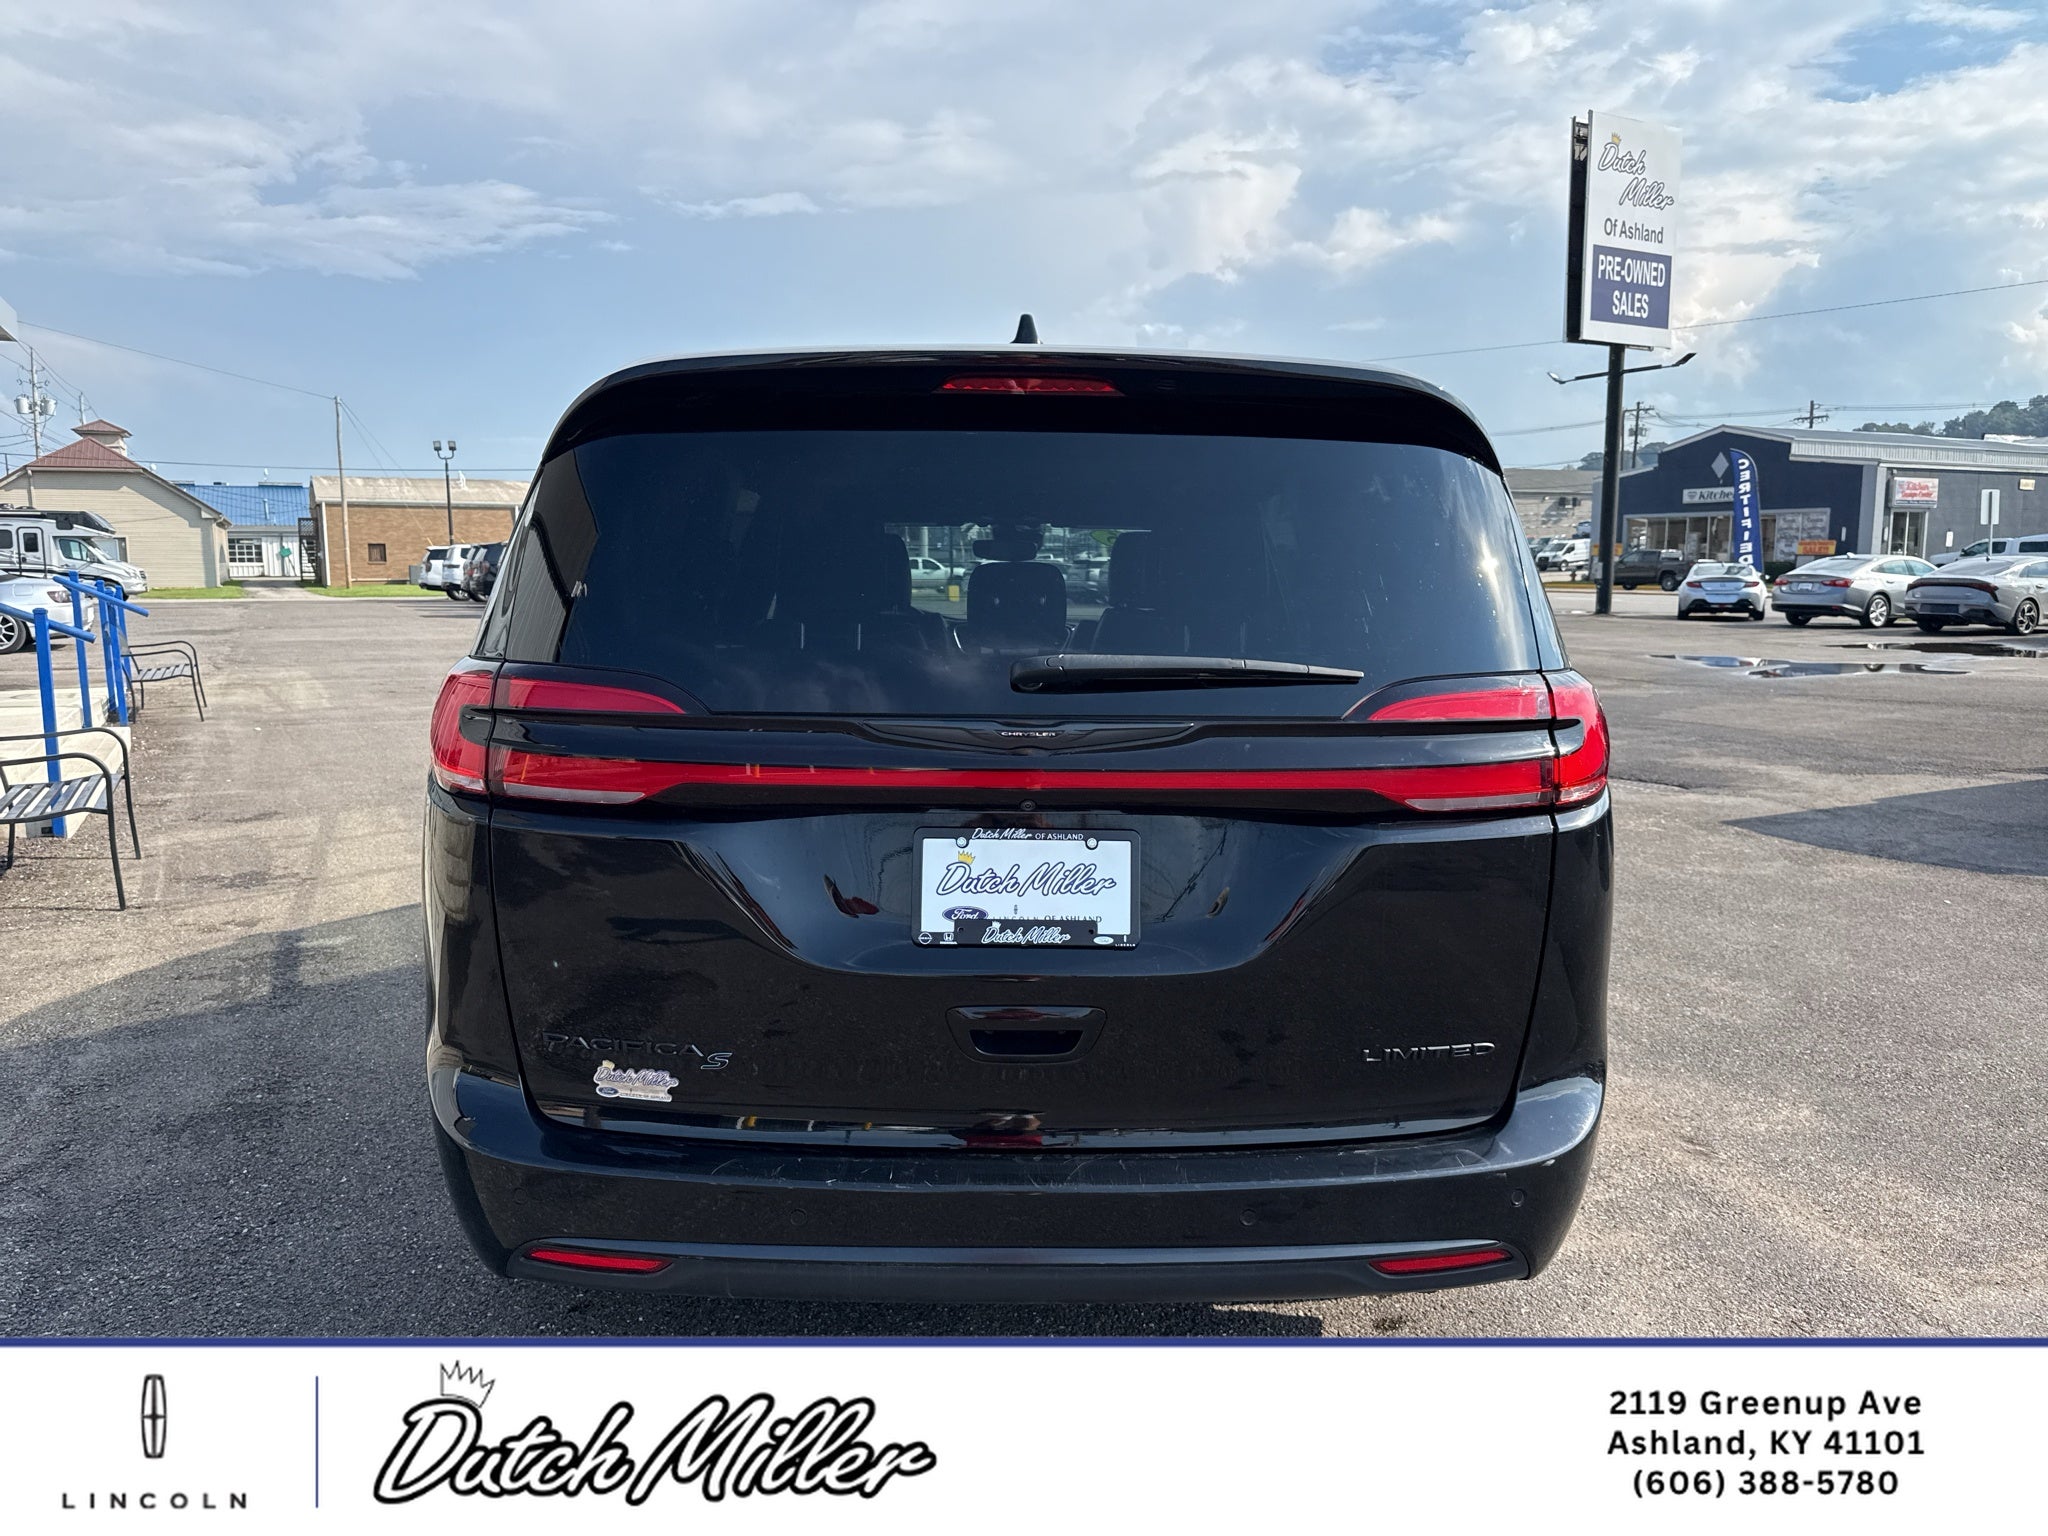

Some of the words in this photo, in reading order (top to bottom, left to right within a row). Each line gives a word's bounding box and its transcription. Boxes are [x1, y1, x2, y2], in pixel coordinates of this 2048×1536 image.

[1598, 142, 1646, 175] Dutch
[1619, 177, 1674, 210] Miller
[1604, 217, 1618, 237] Of
[1619, 219, 1664, 244] Ashland
[1598, 254, 1666, 288] PRE-OWNED
[1612, 290, 1649, 319] SALES
[1698, 489, 1734, 501] Kitche
[971, 827, 1000, 840] Dutch
[999, 827, 1033, 840] Miller
[1035, 832, 1046, 840] OF
[1047, 832, 1084, 841] ASHLAND
[936, 861, 1020, 896] Dutch
[1016, 861, 1117, 897] Miller
[951, 908, 979, 920] Ford
[981, 926, 1023, 944] Dutch
[1021, 926, 1071, 945] Miller
[542, 1032, 704, 1057] PACIFICA
[700, 1052, 733, 1070] S
[1363, 1042, 1496, 1062] LIMITED
[596, 1067, 634, 1084] Dutch
[632, 1068, 677, 1087] Miller
